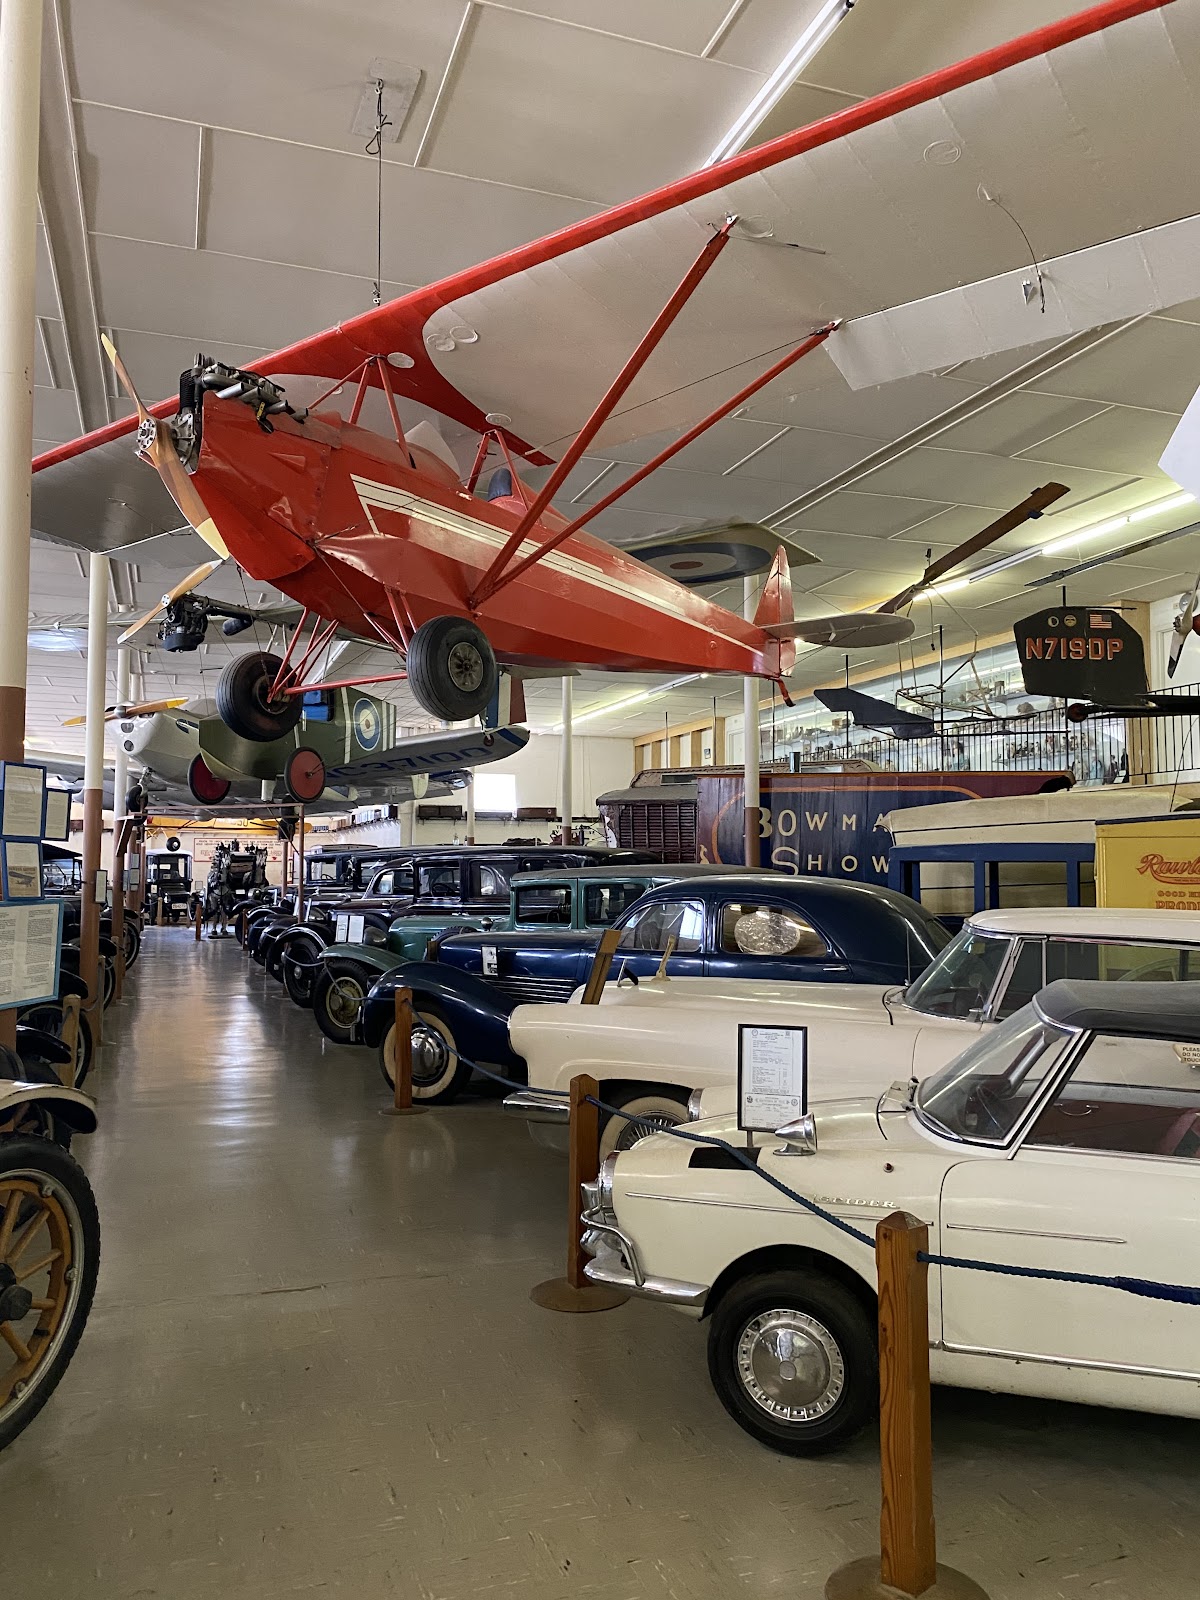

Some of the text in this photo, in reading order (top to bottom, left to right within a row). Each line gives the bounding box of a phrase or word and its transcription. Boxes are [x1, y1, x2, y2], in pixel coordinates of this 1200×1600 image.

[1025, 637, 1124, 660] N719DP
[1157, 890, 1186, 898] GOOD
[819, 1195, 897, 1208] SPIDER
